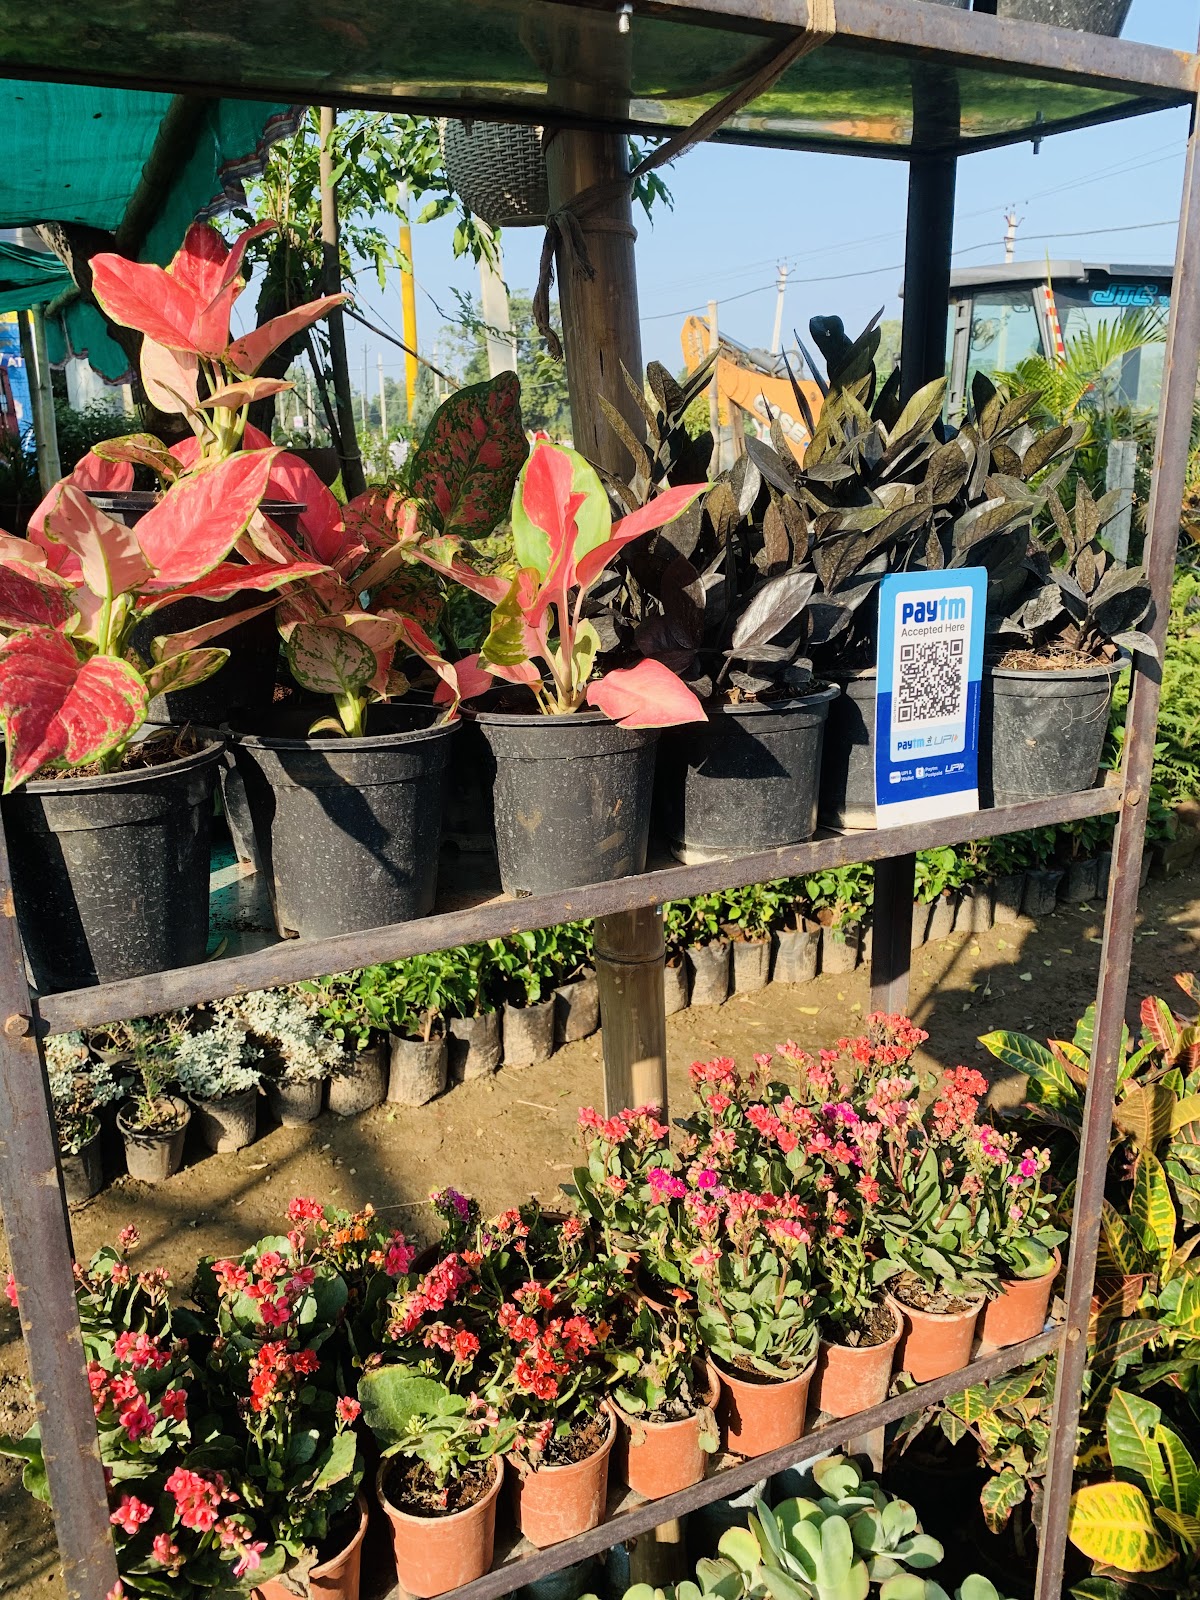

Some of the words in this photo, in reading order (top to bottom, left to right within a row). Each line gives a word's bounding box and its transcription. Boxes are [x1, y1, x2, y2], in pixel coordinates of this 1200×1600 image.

[1091, 284, 1158, 306] JTC
[901, 624, 943, 637] Accepted
[945, 623, 965, 632] Here
[934, 734, 955, 746] UPI
